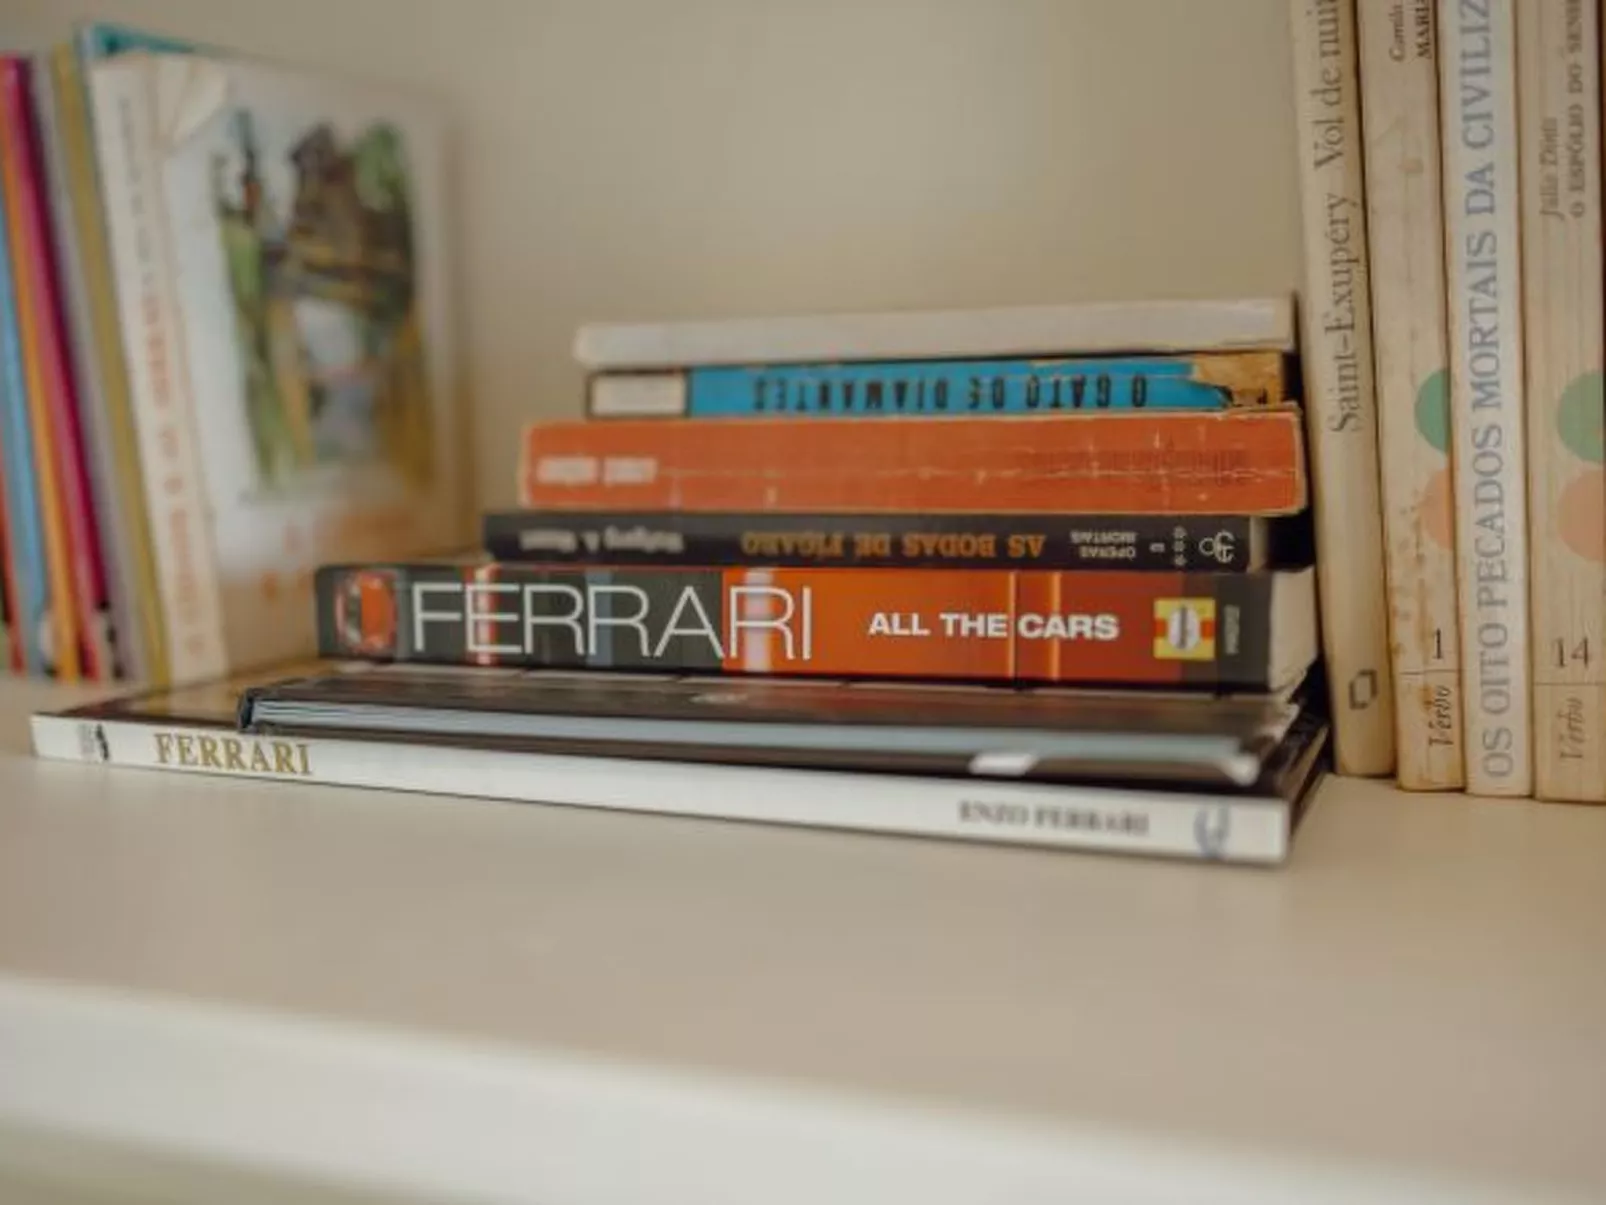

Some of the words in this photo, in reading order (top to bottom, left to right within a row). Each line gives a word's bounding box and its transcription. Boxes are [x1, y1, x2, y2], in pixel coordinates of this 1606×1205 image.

[1309, 68, 1343, 107] de
[1567, 64, 1583, 95] DO
[1313, 115, 1344, 170] Vol
[1463, 162, 1496, 216] DA
[1569, 201, 1586, 219] O
[1324, 192, 1360, 432] Saint-Exupéry
[1465, 229, 1502, 413] MORTAIS
[753, 377, 950, 413] DIAMANTES
[967, 377, 1006, 411] DE
[1027, 375, 1113, 409] GATO
[1133, 376, 1147, 408] O
[1472, 422, 1508, 608] PECADOS
[854, 534, 891, 557] DE
[903, 533, 997, 558] BODAS
[1007, 534, 1046, 557] AS
[410, 582, 812, 660] FERRARI
[868, 612, 930, 636] ALL
[939, 612, 1008, 637] THE
[1017, 613, 1119, 641] CARS
[1431, 628, 1445, 660] 1
[1551, 636, 1591, 669] 14
[1477, 623, 1512, 716] OITO
[1428, 684, 1455, 748] Verbo
[154, 732, 313, 776] FERRARI
[1481, 726, 1513, 778] OS
[1033, 804, 1151, 837] FERRARI
